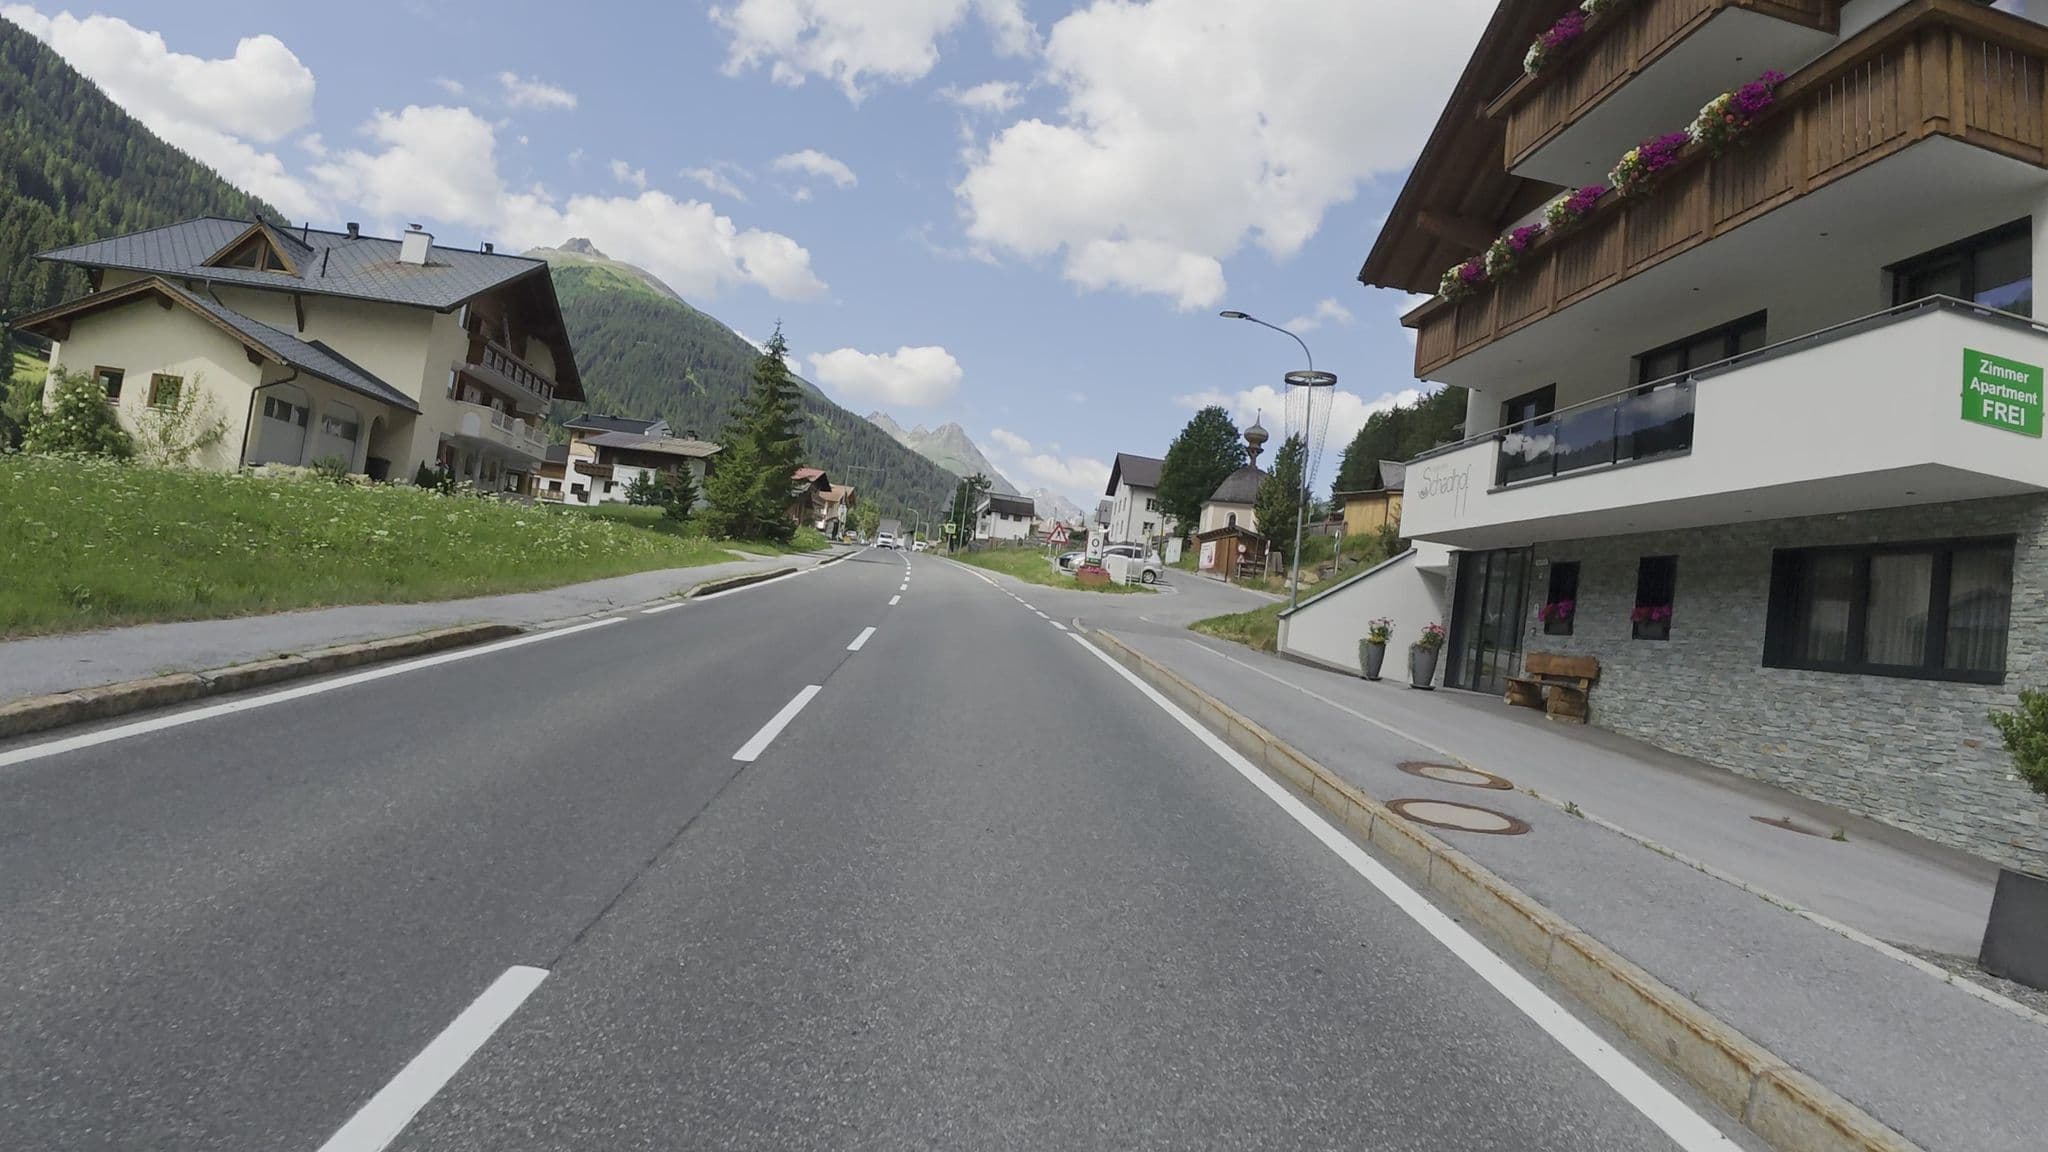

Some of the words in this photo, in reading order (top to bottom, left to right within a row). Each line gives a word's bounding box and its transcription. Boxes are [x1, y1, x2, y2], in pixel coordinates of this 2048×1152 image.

[1980, 359, 2029, 383] Zimmer
[1970, 376, 2038, 405] Apartment
[1983, 399, 2025, 426] FREI
